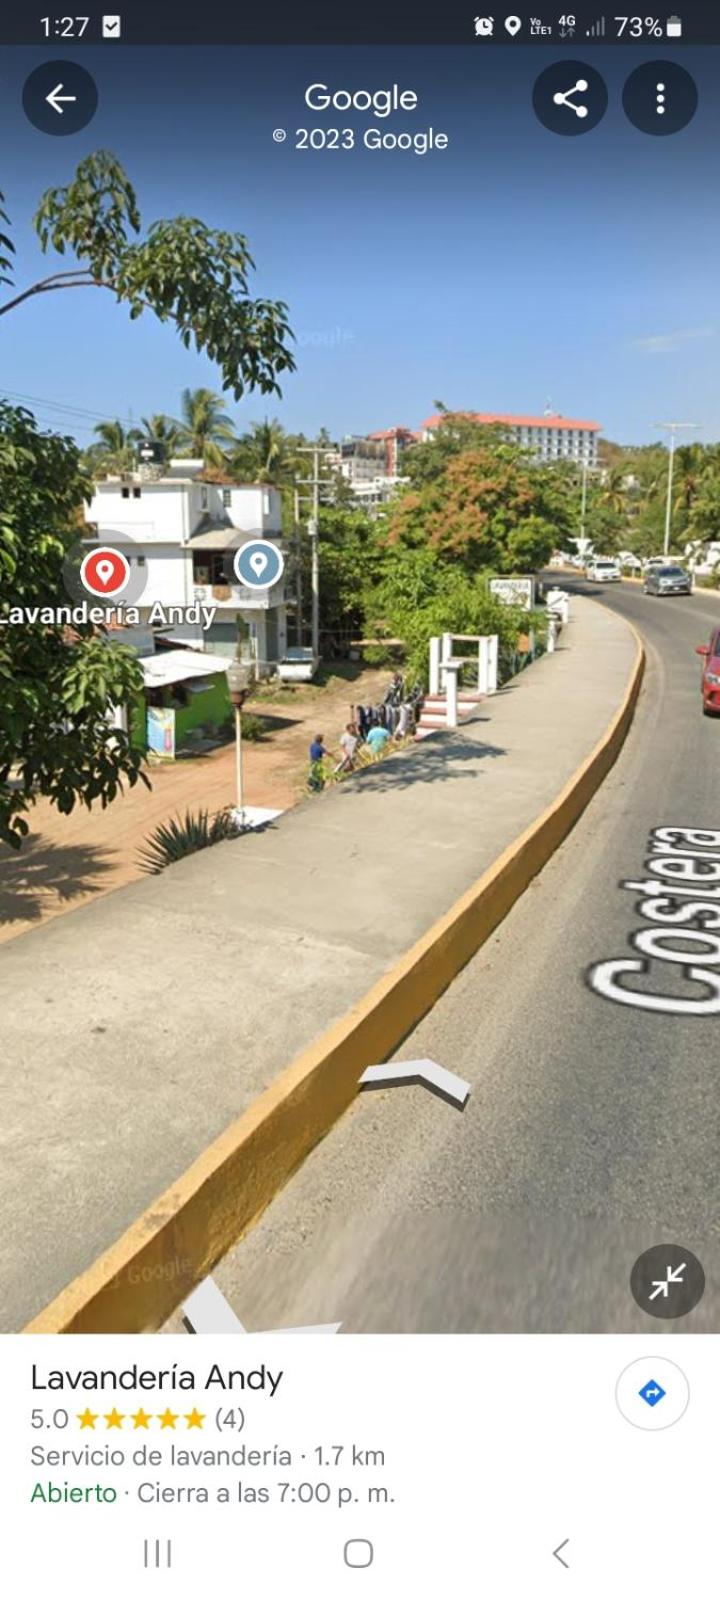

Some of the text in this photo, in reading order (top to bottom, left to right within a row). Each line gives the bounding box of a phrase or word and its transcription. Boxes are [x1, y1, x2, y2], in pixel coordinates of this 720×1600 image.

[41, 17, 89, 37] 1:27
[530, 26, 552, 35] LTE1
[558, 15, 576, 26] 4G
[614, 17, 662, 37] 73%
[32, 1363, 283, 1397] Lavandería Andy
[31, 1407, 244, 1432] 5.0 (4)
[31, 1444, 384, 1466] Servicio de lavandería 1.7 km
[30, 1481, 395, 1508] Abierto Cierra a las 7:00 p. m.
